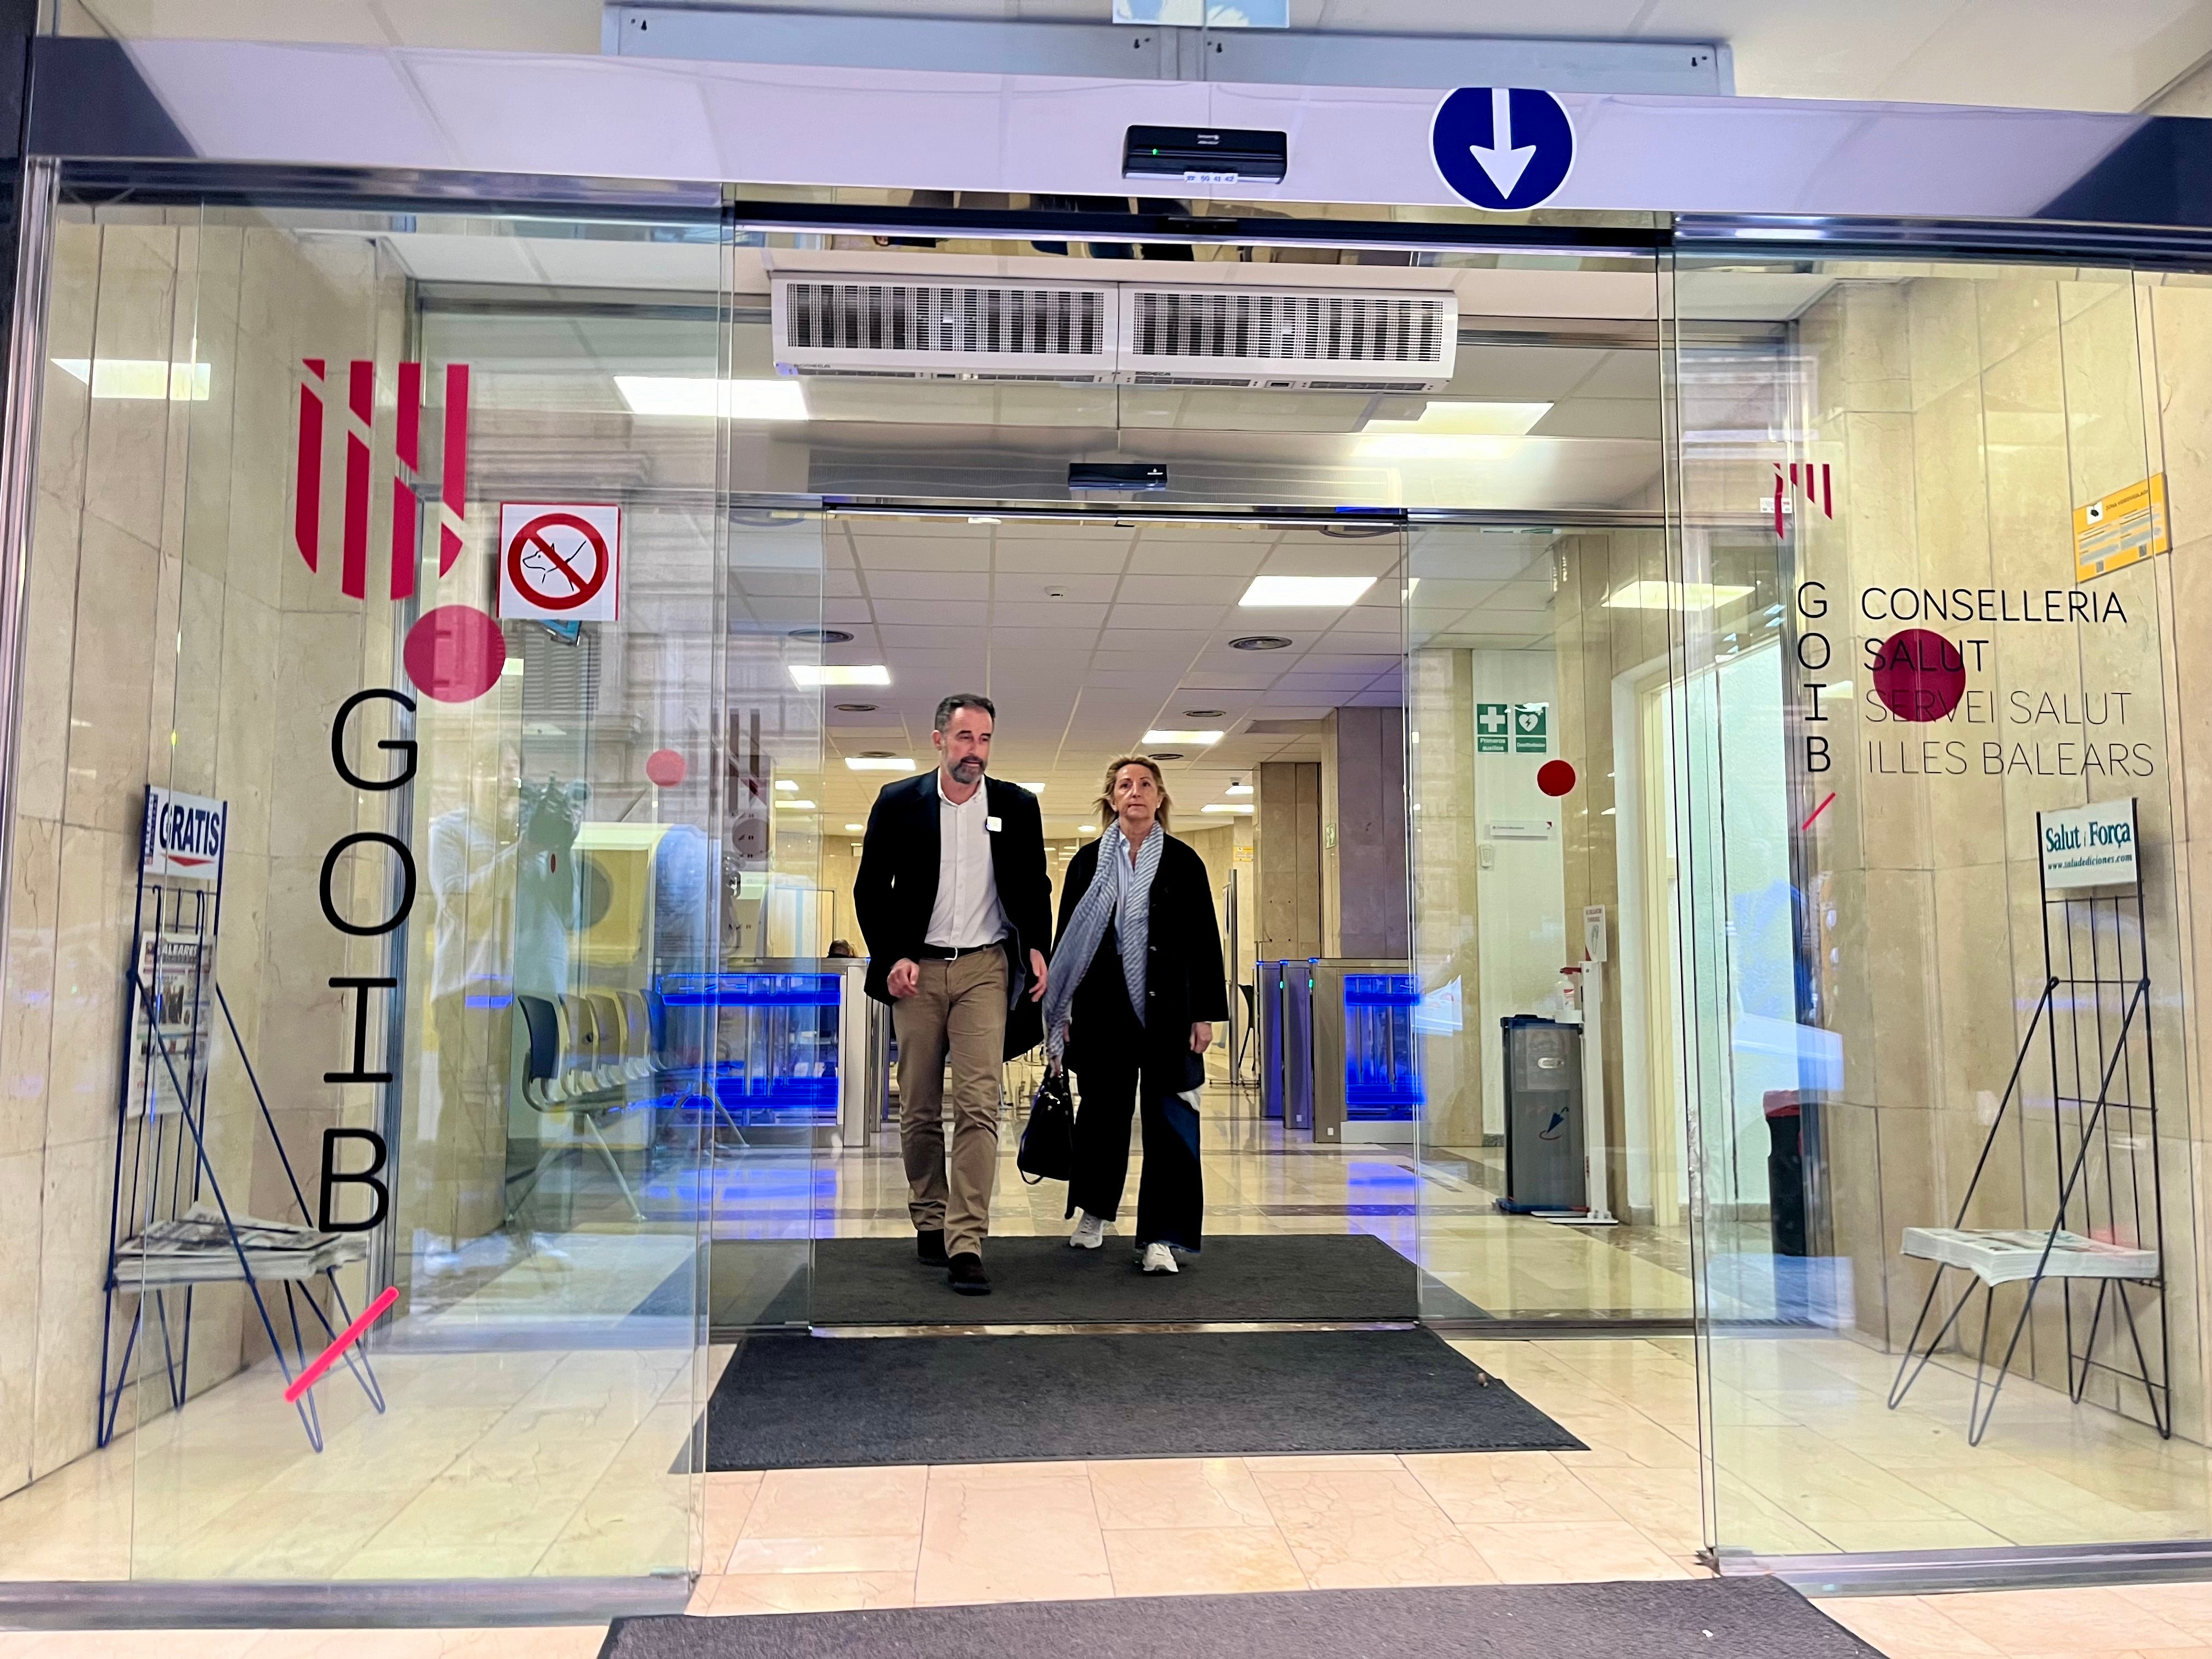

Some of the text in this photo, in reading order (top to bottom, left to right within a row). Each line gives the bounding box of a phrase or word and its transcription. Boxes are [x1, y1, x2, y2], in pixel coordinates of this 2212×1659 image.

[1862, 588, 2128, 623] CONSELLERIA
[1864, 637, 1989, 673] SALUT
[1797, 582, 1832, 773] GOIB
[1865, 689, 2132, 725] SERVEI SALUT
[1868, 740, 2154, 777] ILLES BALEARS
[160, 802, 220, 856] GRATIS
[2046, 823, 2081, 852] Salut
[2088, 821, 2131, 849] Força
[2047, 854, 2132, 870] www.saludediciones.com
[319, 688, 417, 1233] GOIB
